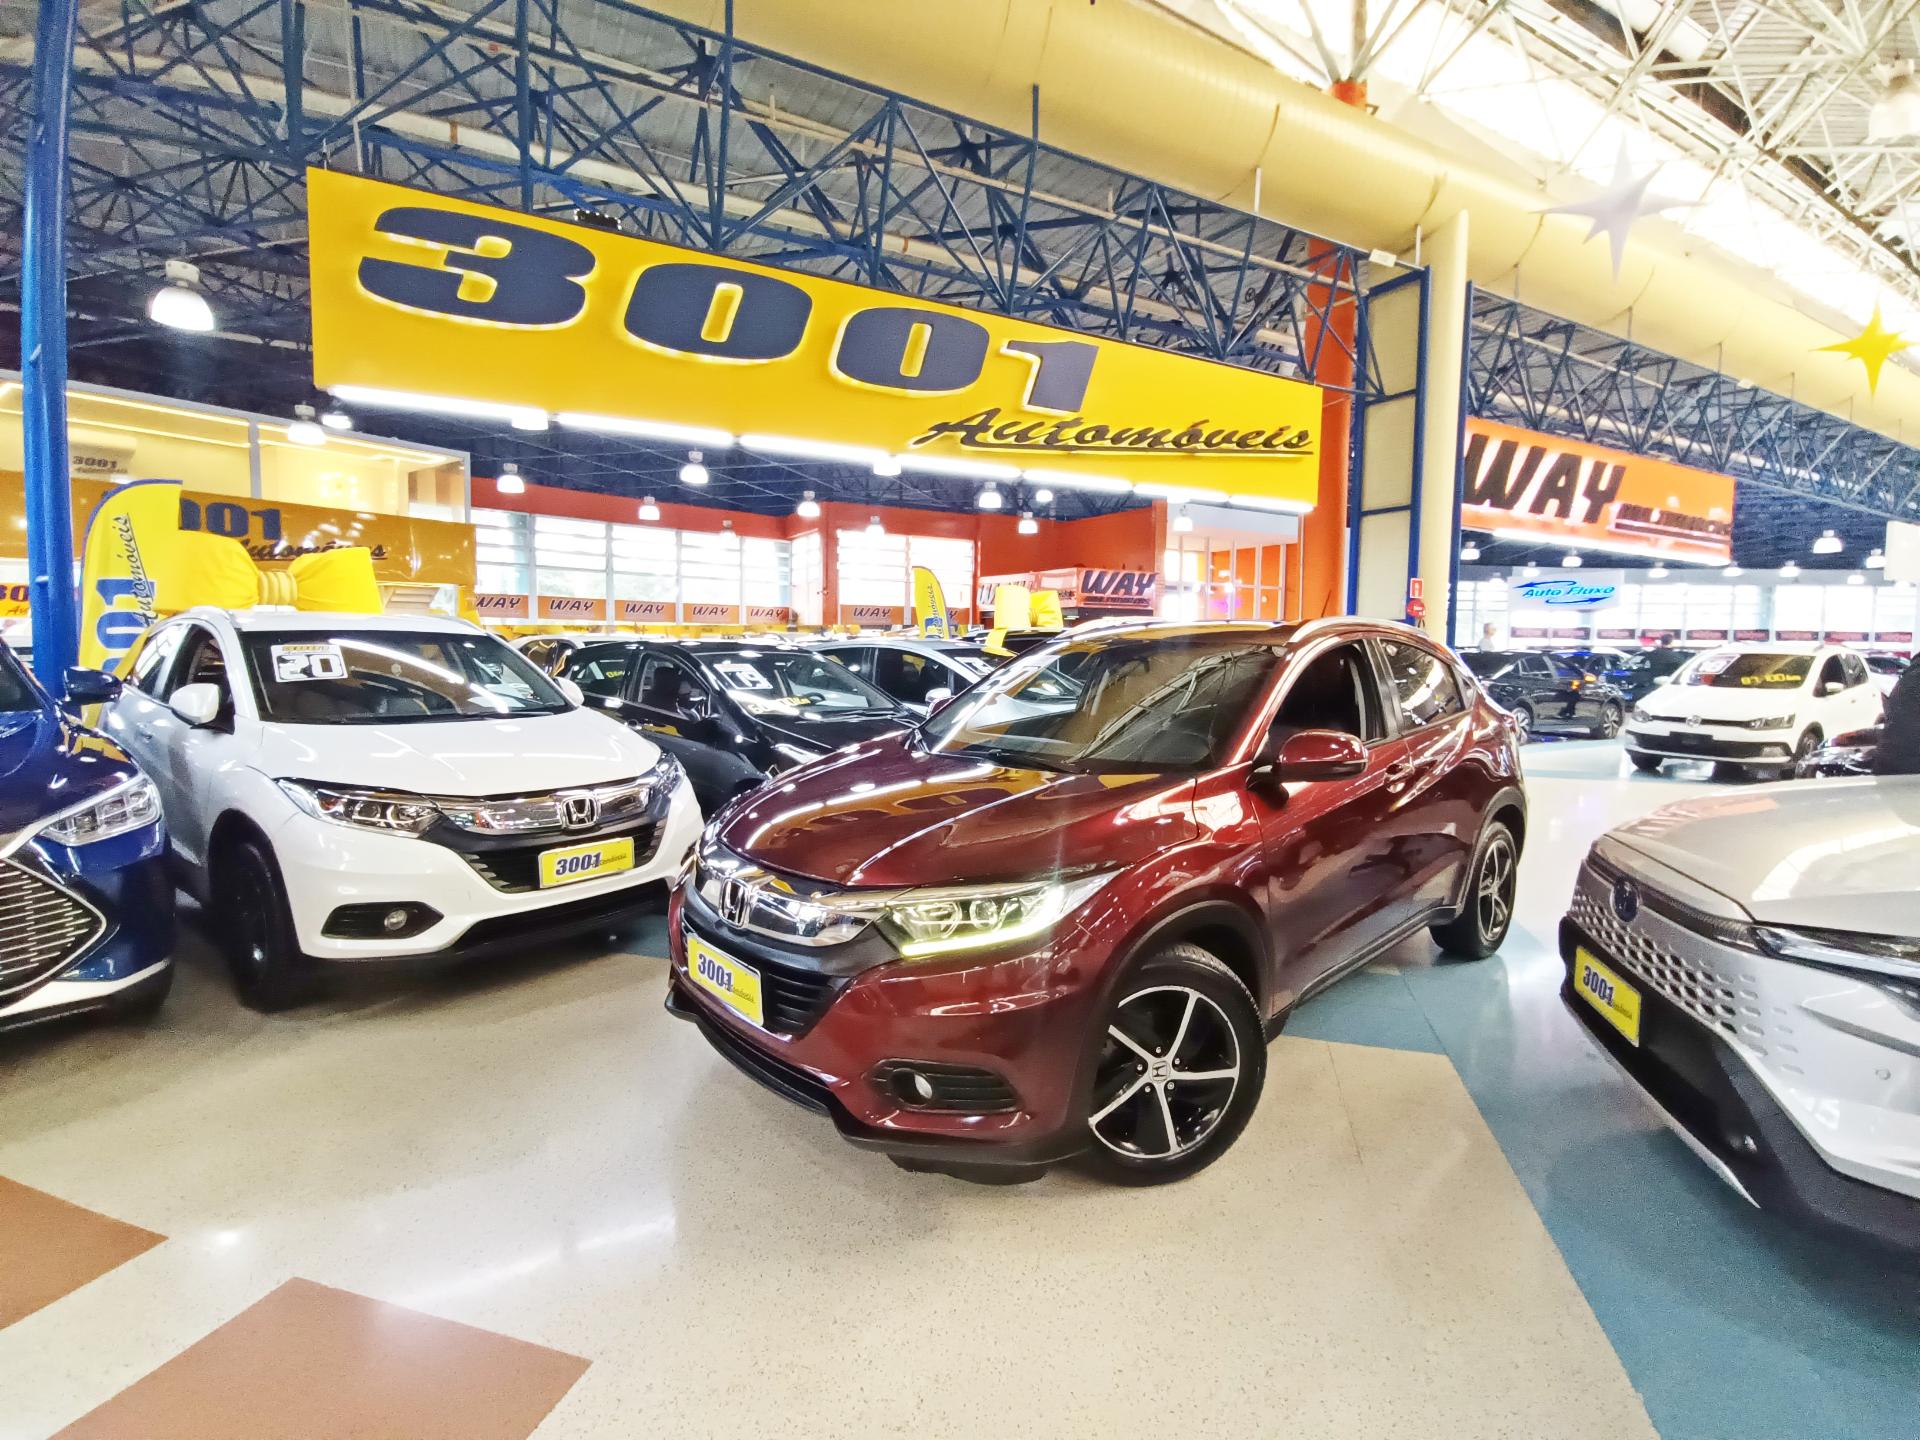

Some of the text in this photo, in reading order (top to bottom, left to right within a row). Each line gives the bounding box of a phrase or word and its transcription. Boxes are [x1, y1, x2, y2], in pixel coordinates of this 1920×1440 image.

[358, 207, 1099, 413] 3001
[912, 408, 1314, 455] Automóveis
[1464, 434, 1627, 524] WAY
[1081, 570, 1157, 597] WAY
[1522, 586, 1616, 598] Auto Fluxo
[550, 600, 594, 611] WAY
[625, 603, 665, 614] WAY
[692, 606, 729, 616] WAY
[750, 607, 784, 617] WAY
[853, 607, 892, 618] WAY
[277, 655, 345, 680] 20
[555, 852, 602, 876] 3001
[697, 953, 733, 993] 3001
[1582, 965, 1615, 1007] 3001
